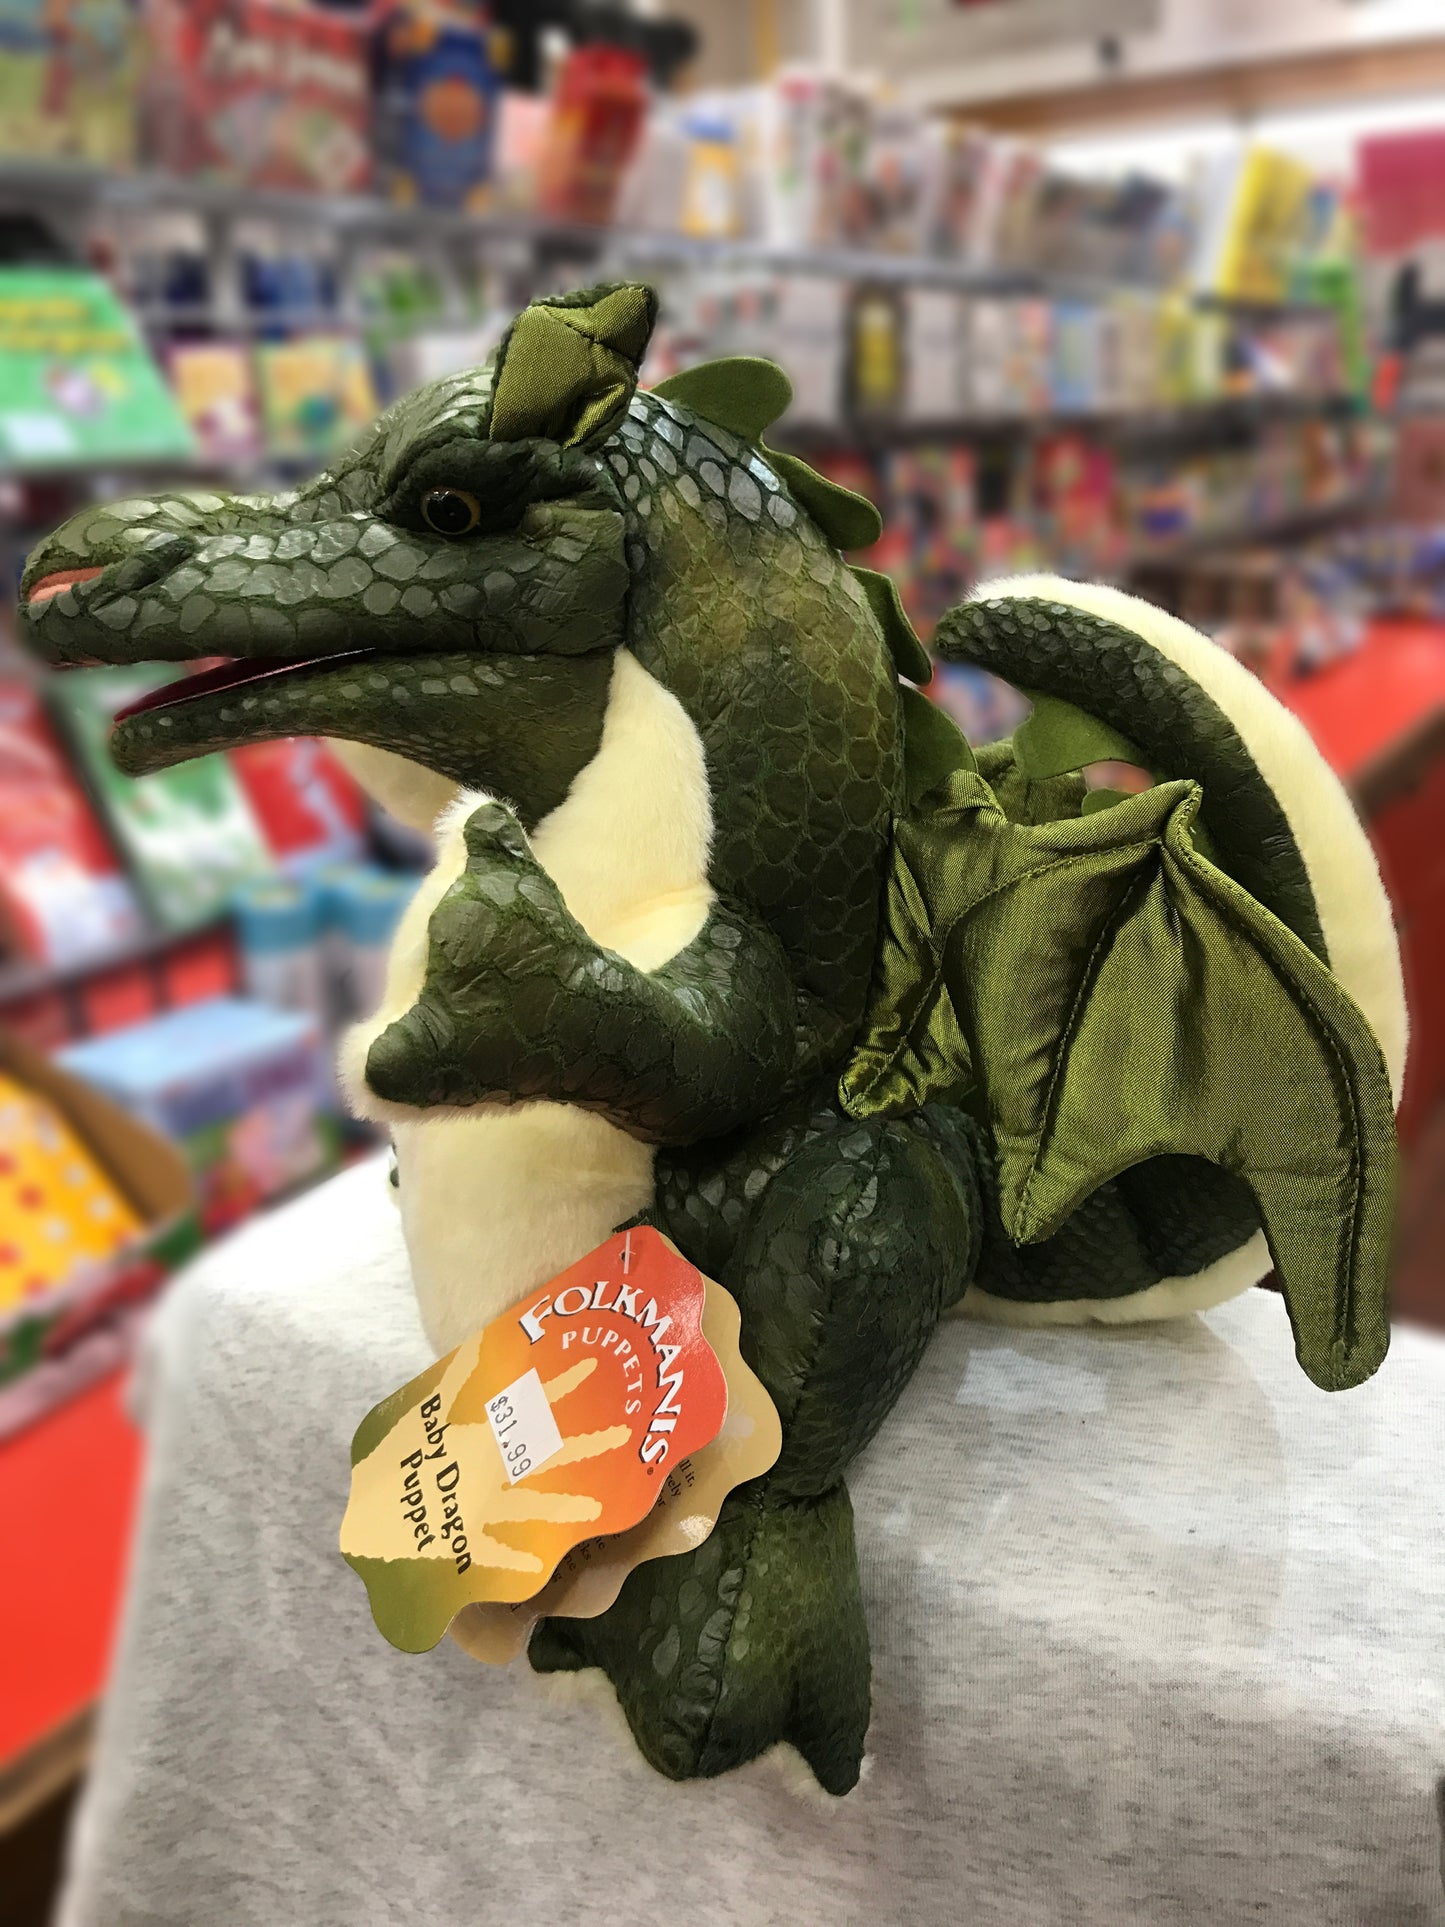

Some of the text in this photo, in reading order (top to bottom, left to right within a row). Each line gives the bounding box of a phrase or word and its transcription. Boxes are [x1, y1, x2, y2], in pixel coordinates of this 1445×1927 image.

[562, 1327, 643, 1415] PUPPETS
[420, 1392, 472, 1575] Baby Dragon
[490, 1395, 532, 1477] $31.99
[400, 1448, 436, 1552] Puppet
